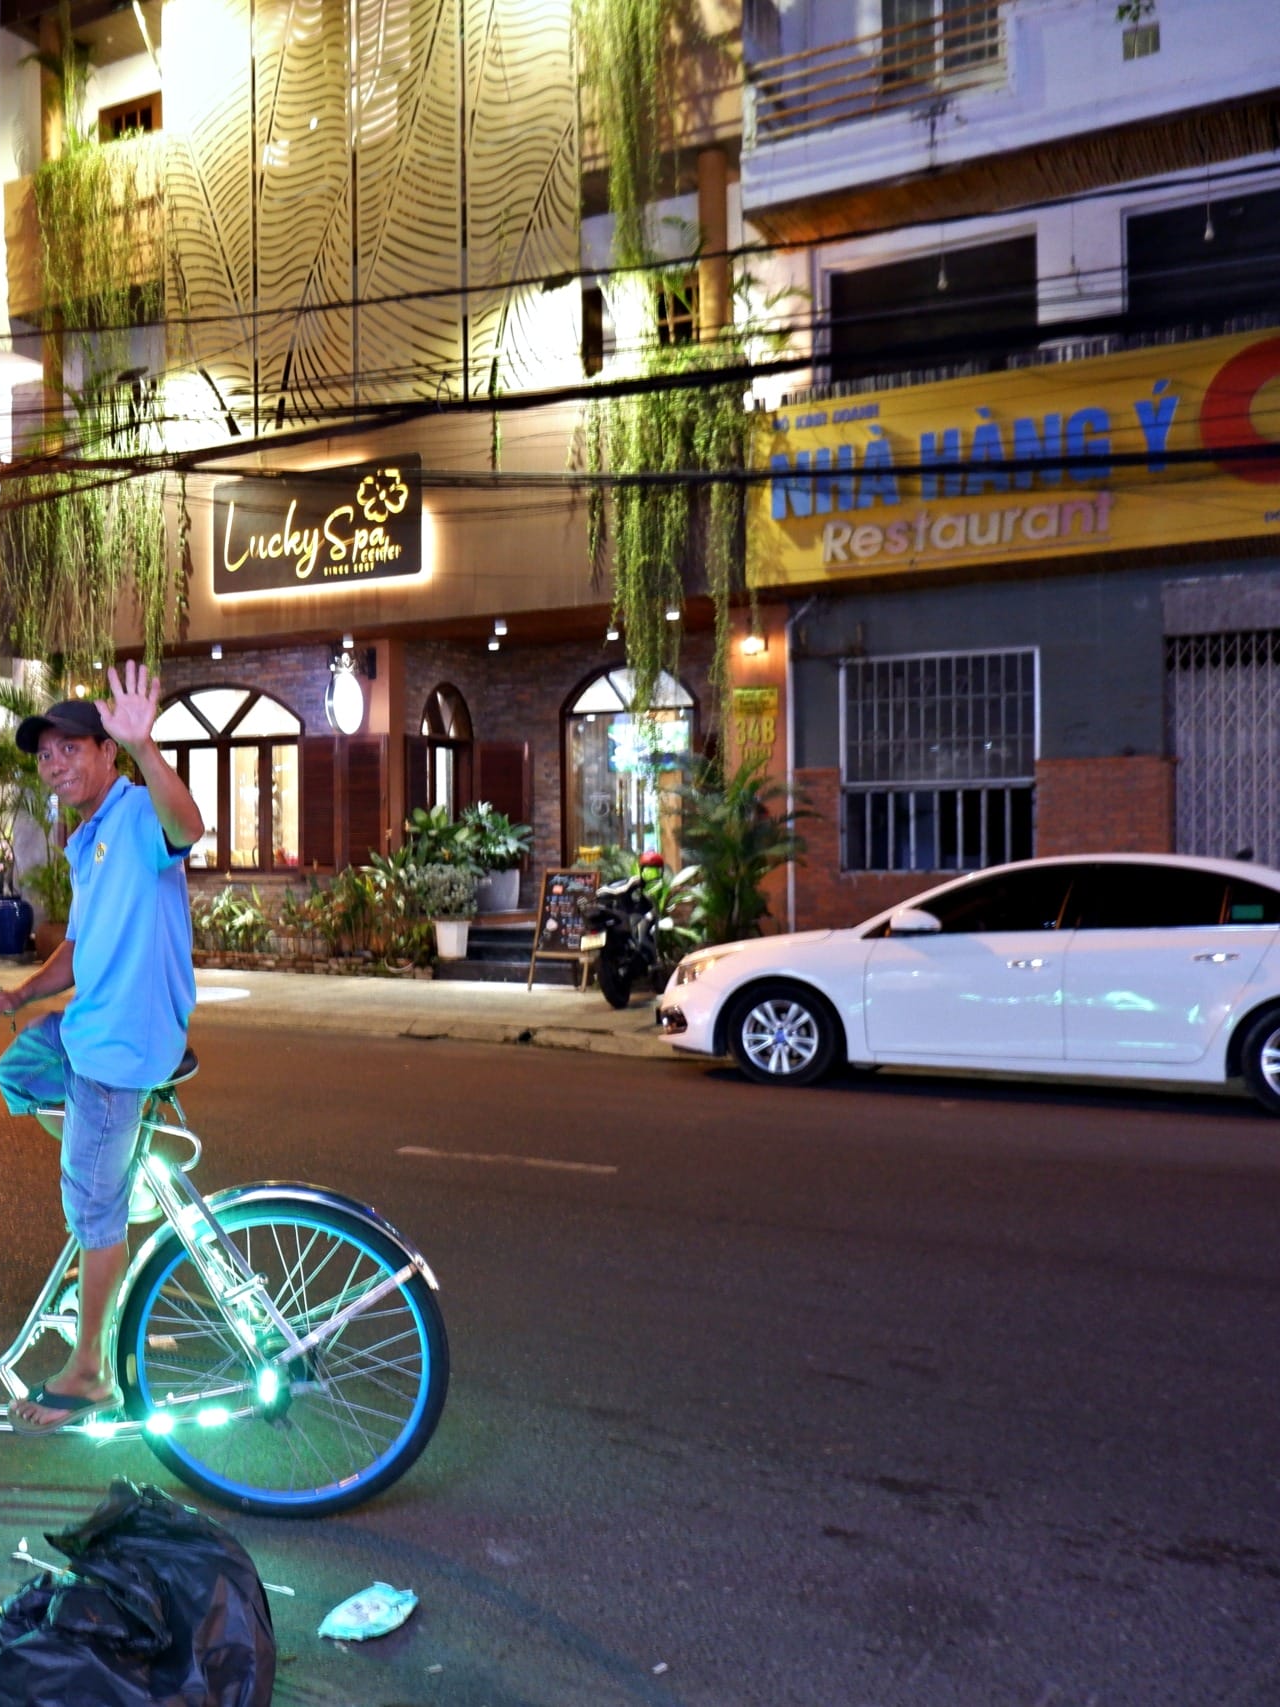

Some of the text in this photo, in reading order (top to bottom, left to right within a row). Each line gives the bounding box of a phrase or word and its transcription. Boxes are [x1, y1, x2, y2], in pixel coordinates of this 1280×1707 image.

[769, 378, 1180, 520] NHÀ HÀNG Ý
[223, 499, 386, 579] Lucky Spa
[822, 490, 1114, 563] Restaurant
